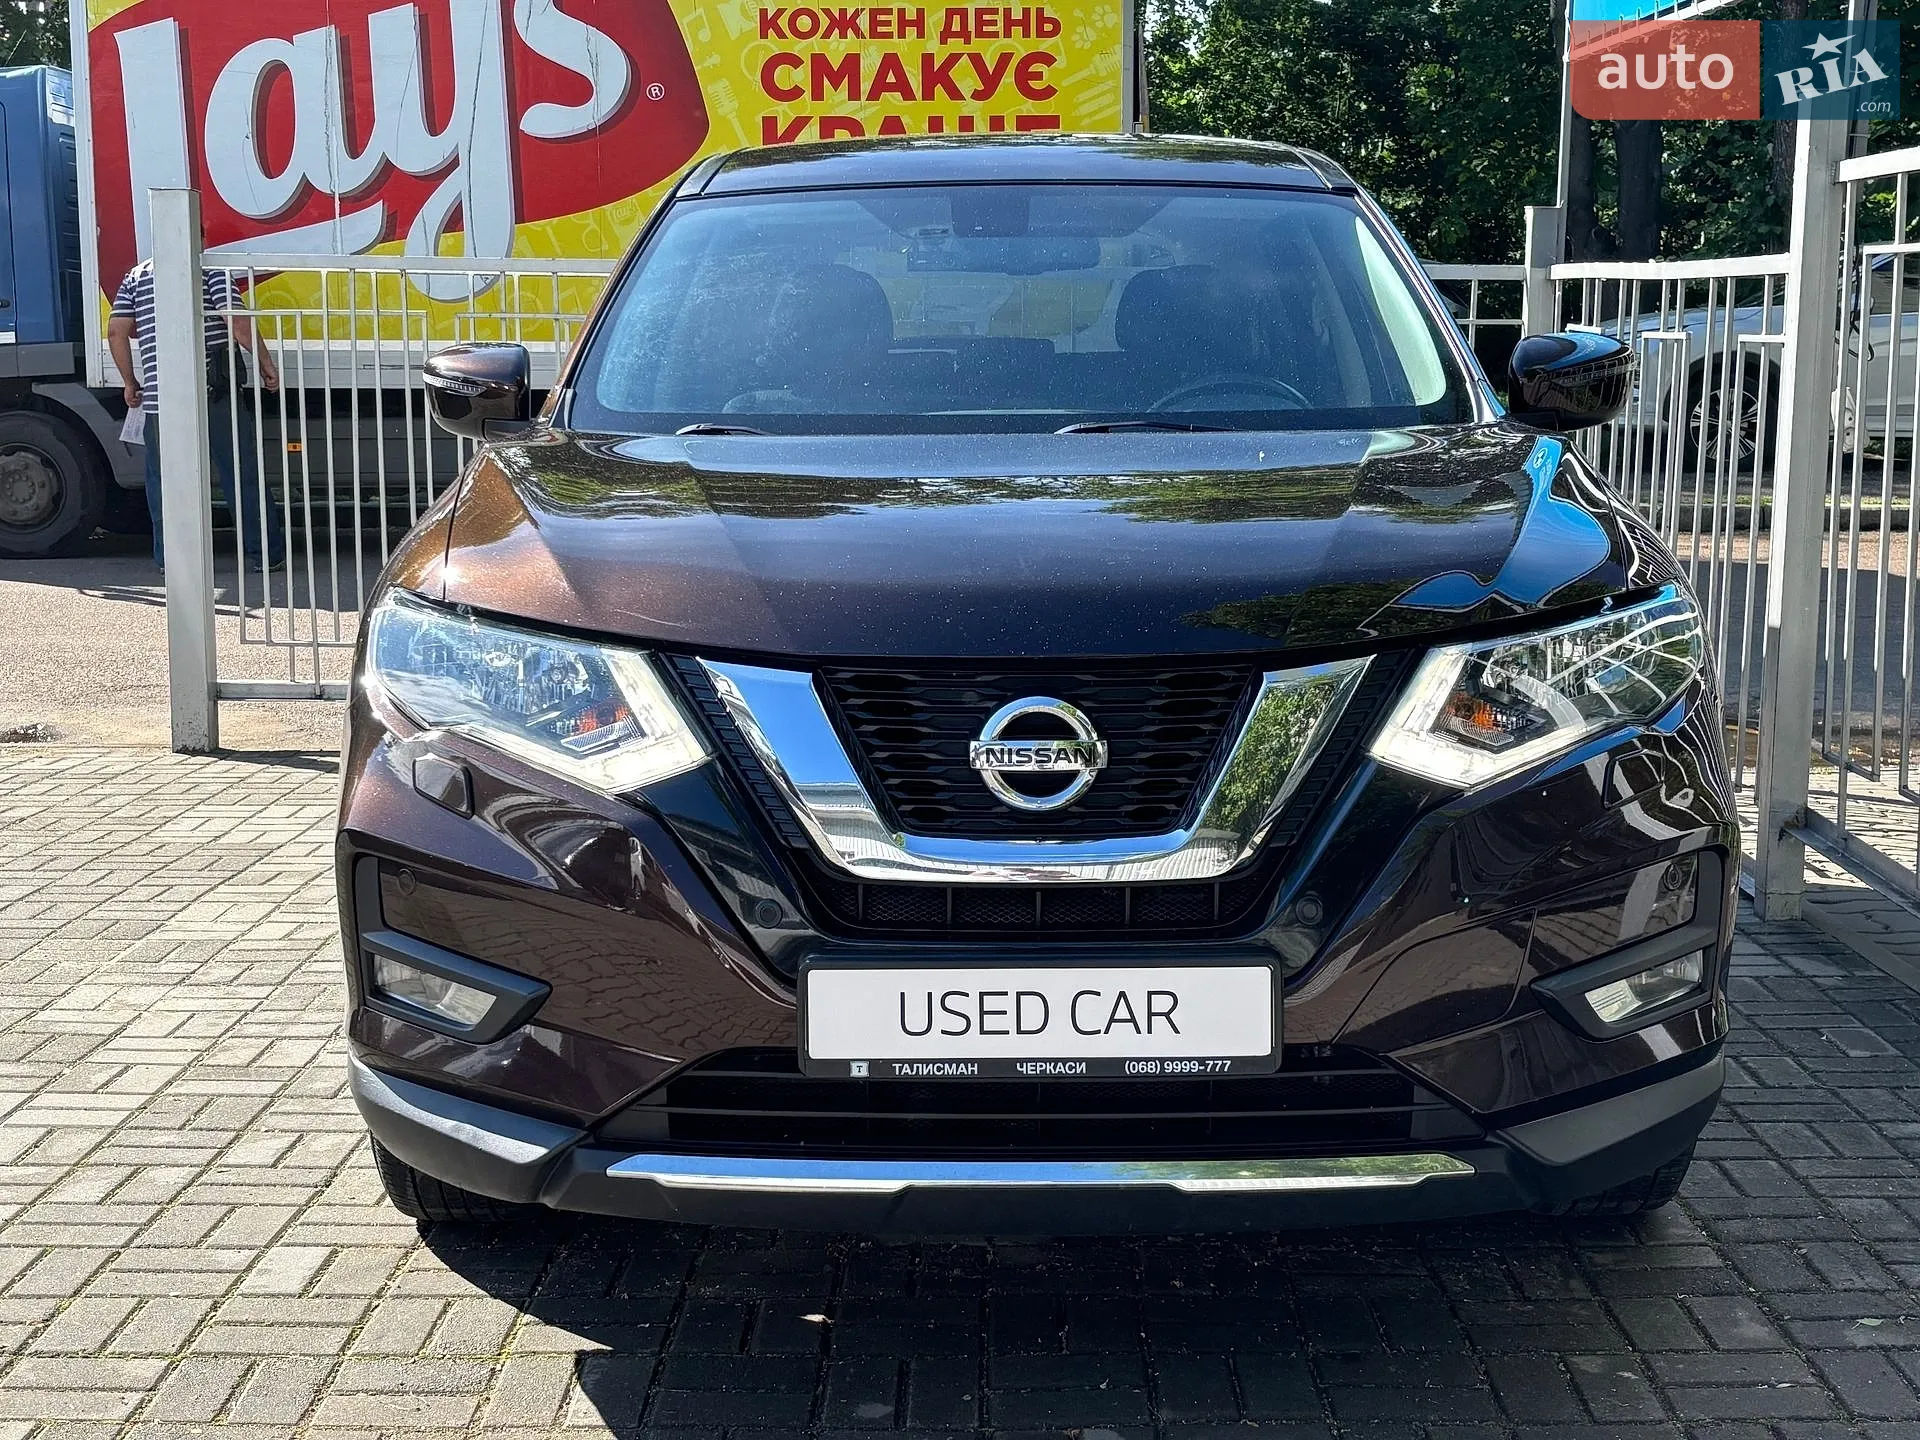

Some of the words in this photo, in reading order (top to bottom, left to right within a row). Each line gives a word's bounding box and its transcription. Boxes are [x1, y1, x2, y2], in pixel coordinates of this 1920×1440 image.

[758, 7, 927, 41] КОЖЕН
[938, 7, 1062, 46] ДЕНЬ
[759, 51, 1060, 103] СМАКУЄ
[985, 746, 1096, 765] NISSAN
[899, 990, 1050, 1037] USED
[1070, 989, 1181, 1036] CAR
[892, 1062, 979, 1076] ТАЛИСМАН
[1016, 1061, 1087, 1075] ЧЕРКАСИ
[1124, 1060, 1161, 1075] (068)
[1163, 1059, 1232, 1073] 9999-777
